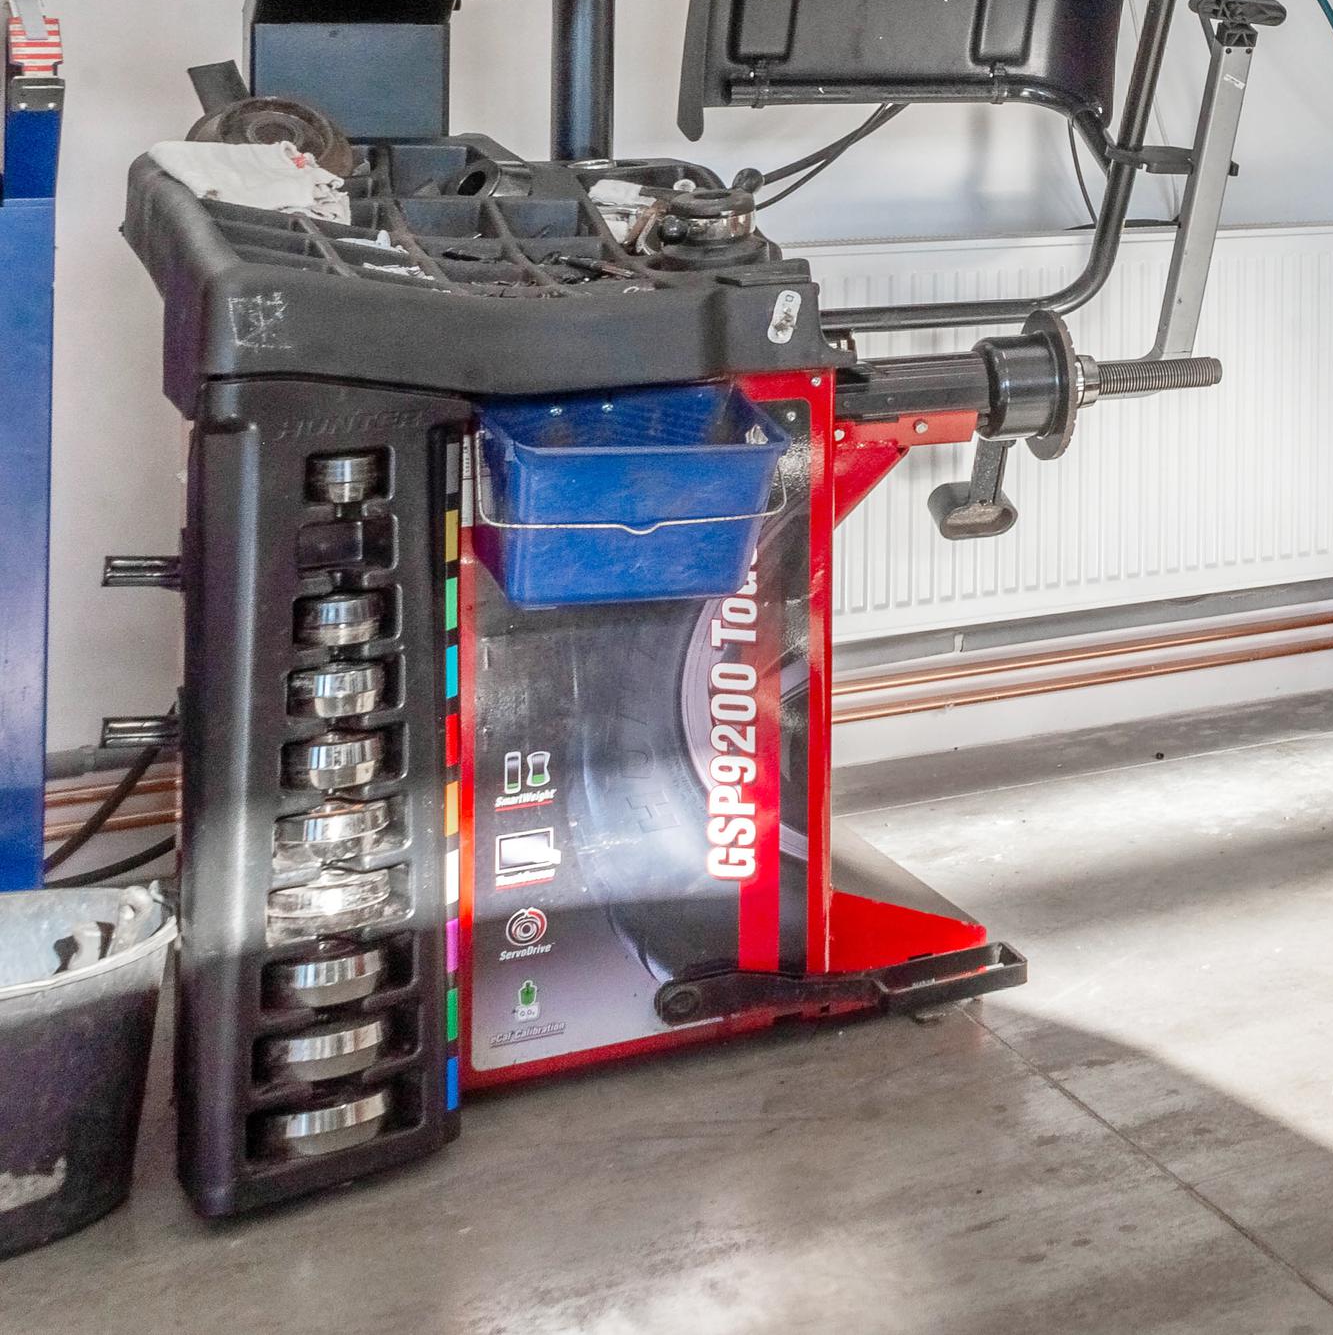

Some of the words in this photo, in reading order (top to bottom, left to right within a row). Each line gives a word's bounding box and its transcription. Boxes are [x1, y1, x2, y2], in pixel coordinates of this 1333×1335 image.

[706, 662, 758, 880] GSP9200
[496, 788, 557, 808] SmartWeight
[499, 942, 552, 962] ServoDrive
[513, 1020, 566, 1041] Calibration
